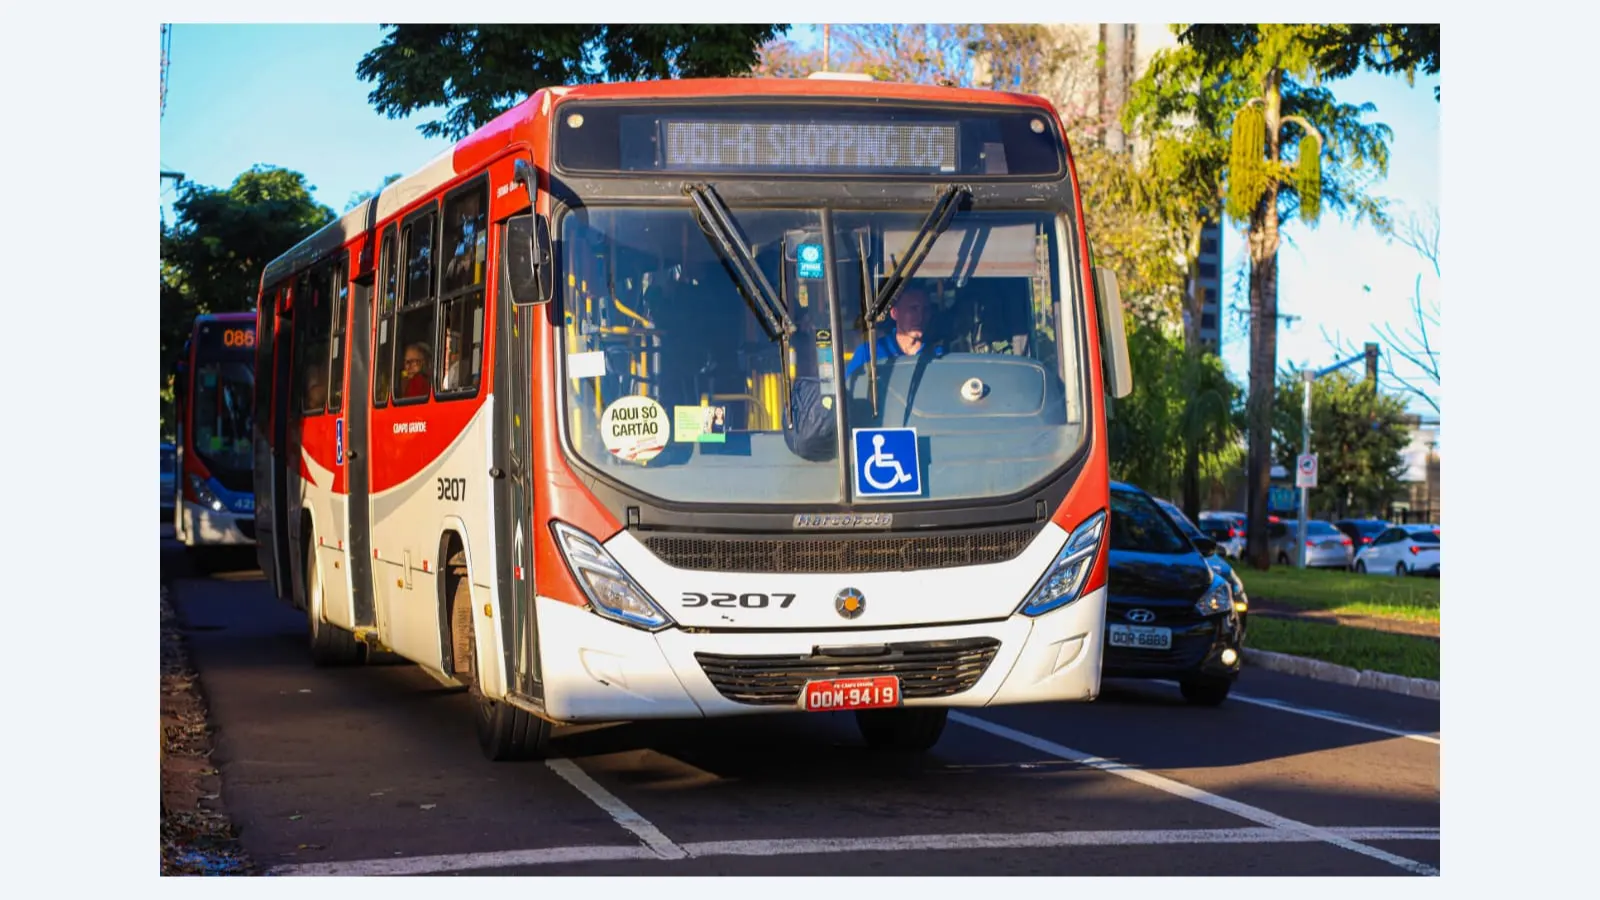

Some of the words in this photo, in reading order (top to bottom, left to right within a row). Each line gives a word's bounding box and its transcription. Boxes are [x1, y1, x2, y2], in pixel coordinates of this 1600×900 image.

[670, 122, 756, 164] 061-A
[768, 123, 900, 166] SHOPPING
[909, 125, 944, 167] CG
[223, 329, 255, 348] 086
[611, 407, 639, 421] AQUI
[641, 403, 658, 419] SÓ
[612, 419, 658, 437] CARTÃO
[437, 477, 466, 502] 3207
[797, 513, 891, 528] Marcopolo
[681, 591, 797, 609] 3207
